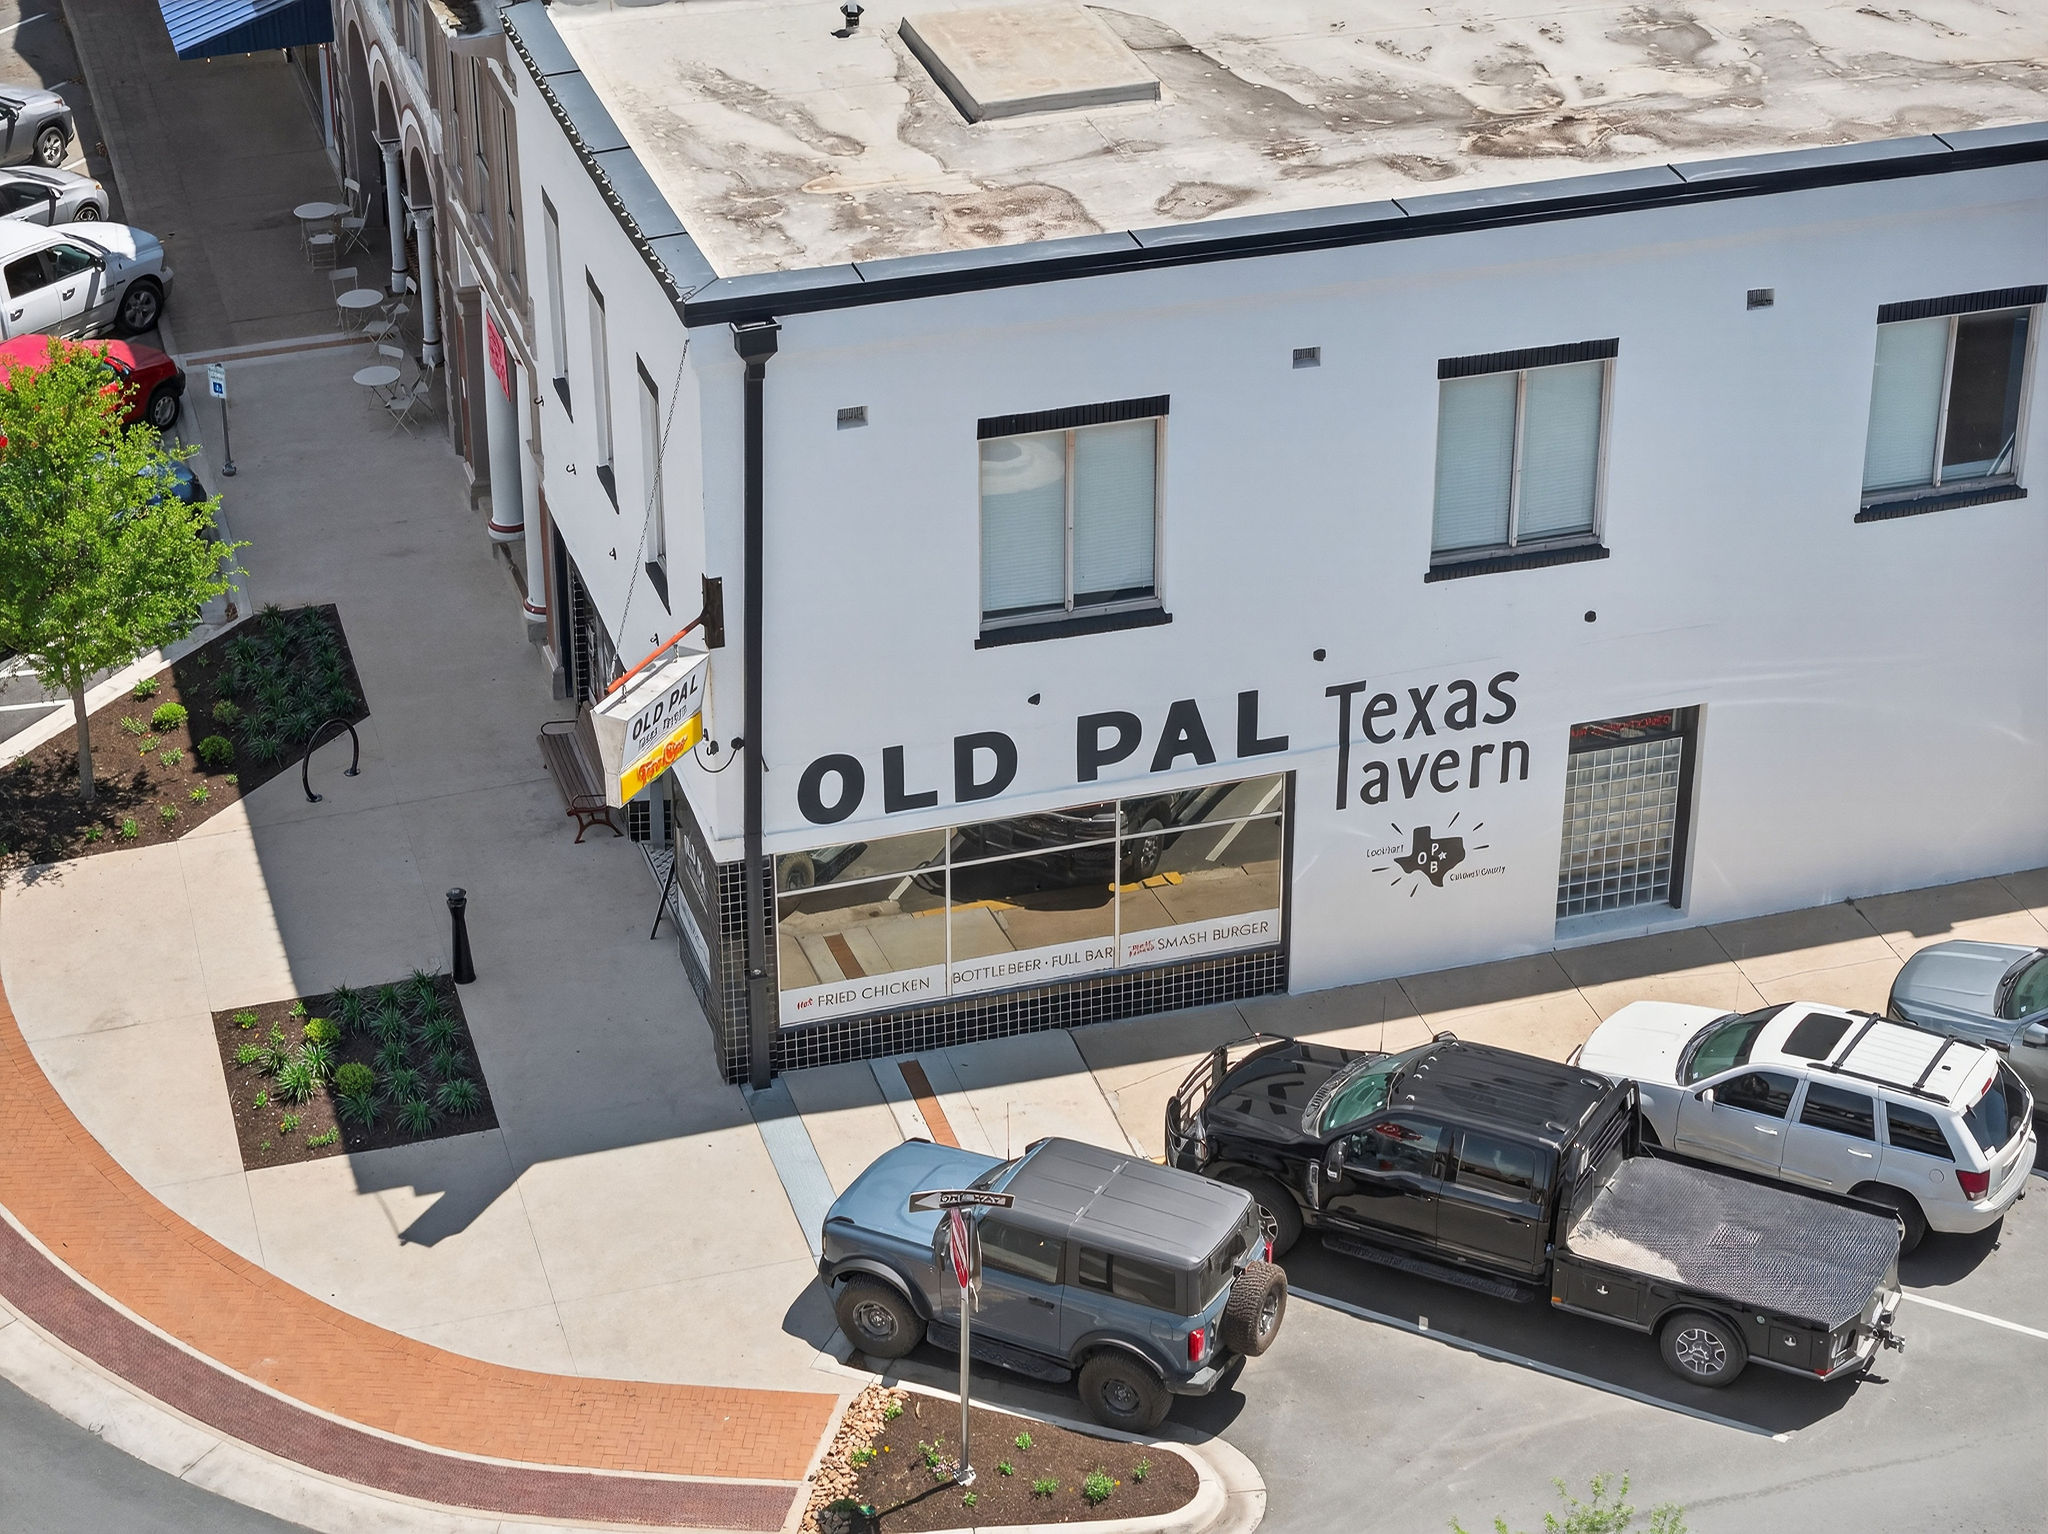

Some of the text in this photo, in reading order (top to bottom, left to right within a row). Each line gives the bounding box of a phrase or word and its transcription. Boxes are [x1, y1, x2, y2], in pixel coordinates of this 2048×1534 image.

[632, 701, 664, 741] OLD
[669, 674, 698, 712] PAL
[1325, 671, 1520, 747] Texas
[798, 730, 1017, 825] OLD
[1077, 689, 1290, 783] PAL
[1157, 931, 1208, 951] SMASH
[1212, 920, 1270, 942] BURGER
[818, 990, 857, 1008] FRIED
[861, 976, 930, 1000] CHICKEN
[952, 965, 1006, 985] BOTTLE
[1008, 958, 1042, 976] BEER
[1051, 950, 1082, 969] FULL
[1085, 946, 1115, 962] BAR
